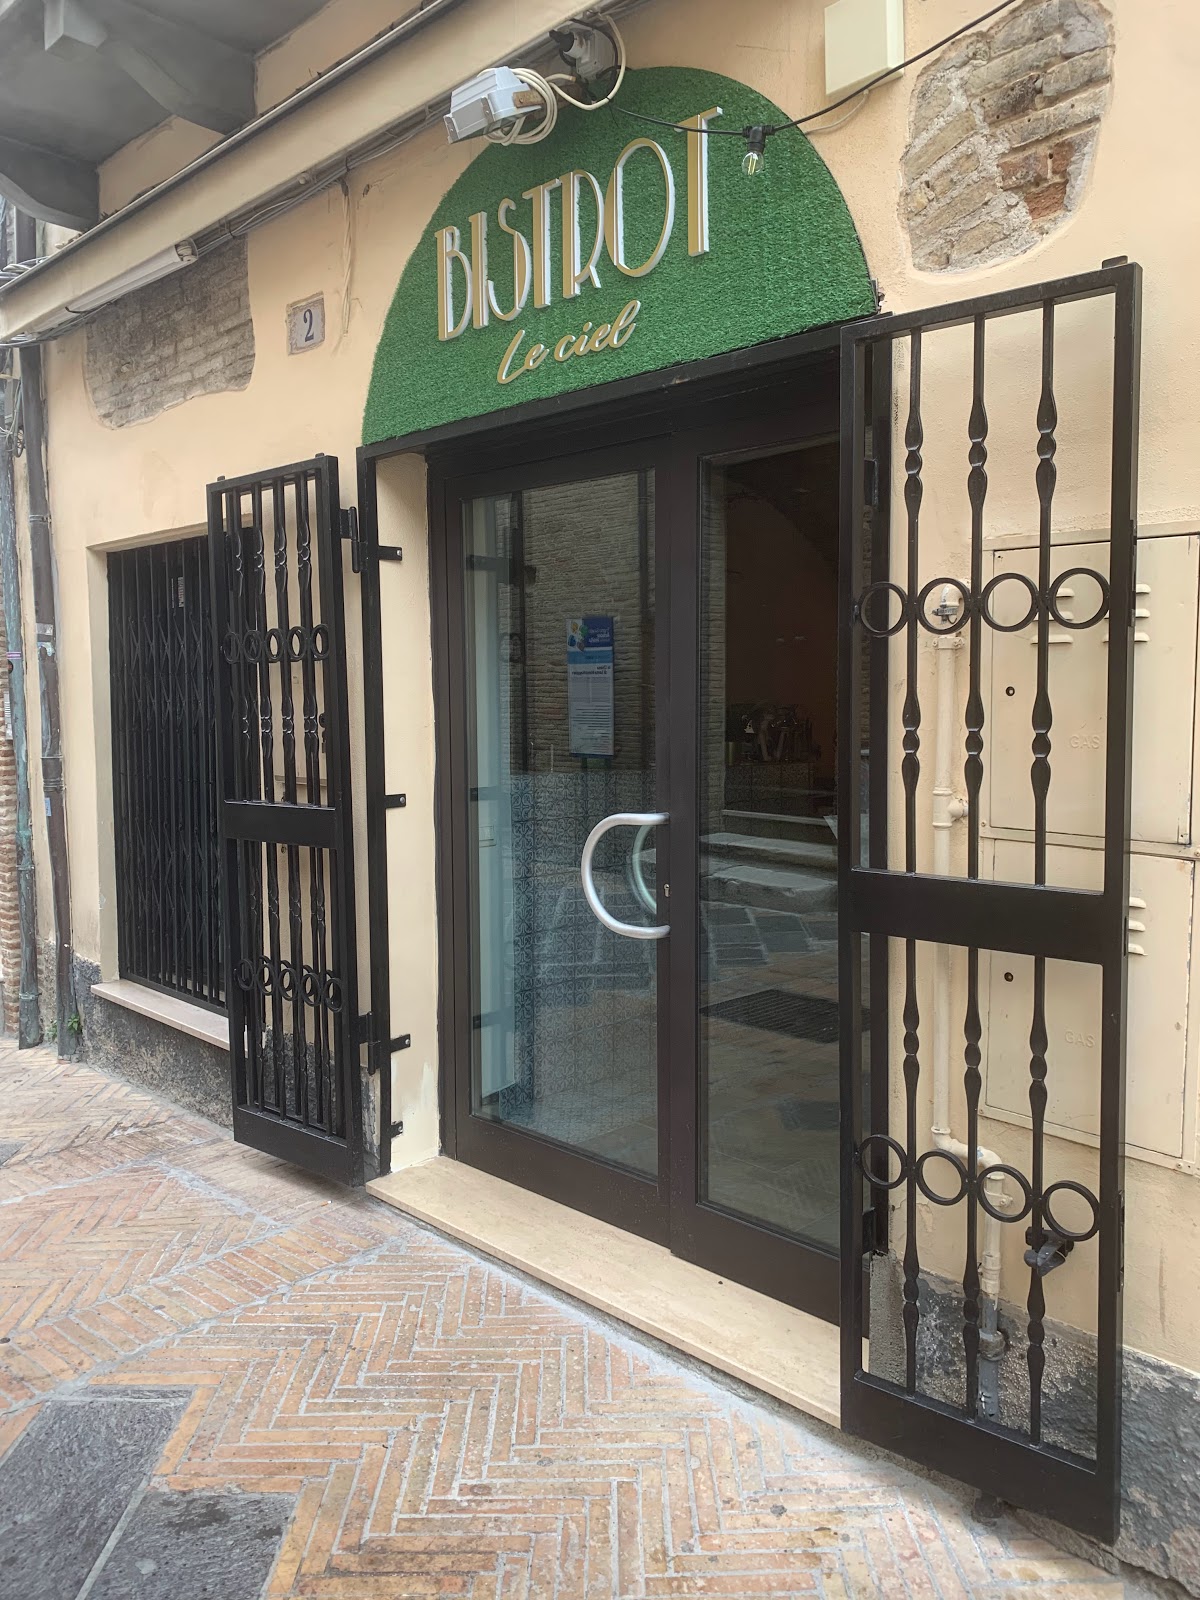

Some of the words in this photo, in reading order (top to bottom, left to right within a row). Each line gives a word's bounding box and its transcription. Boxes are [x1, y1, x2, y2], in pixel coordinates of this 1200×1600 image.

[434, 106, 723, 342] BISTROT
[303, 309, 314, 342] 2
[496, 329, 550, 384] Le
[554, 300, 641, 362] ciel
[1069, 734, 1100, 750] GAS
[1064, 1030, 1096, 1049] GAS
